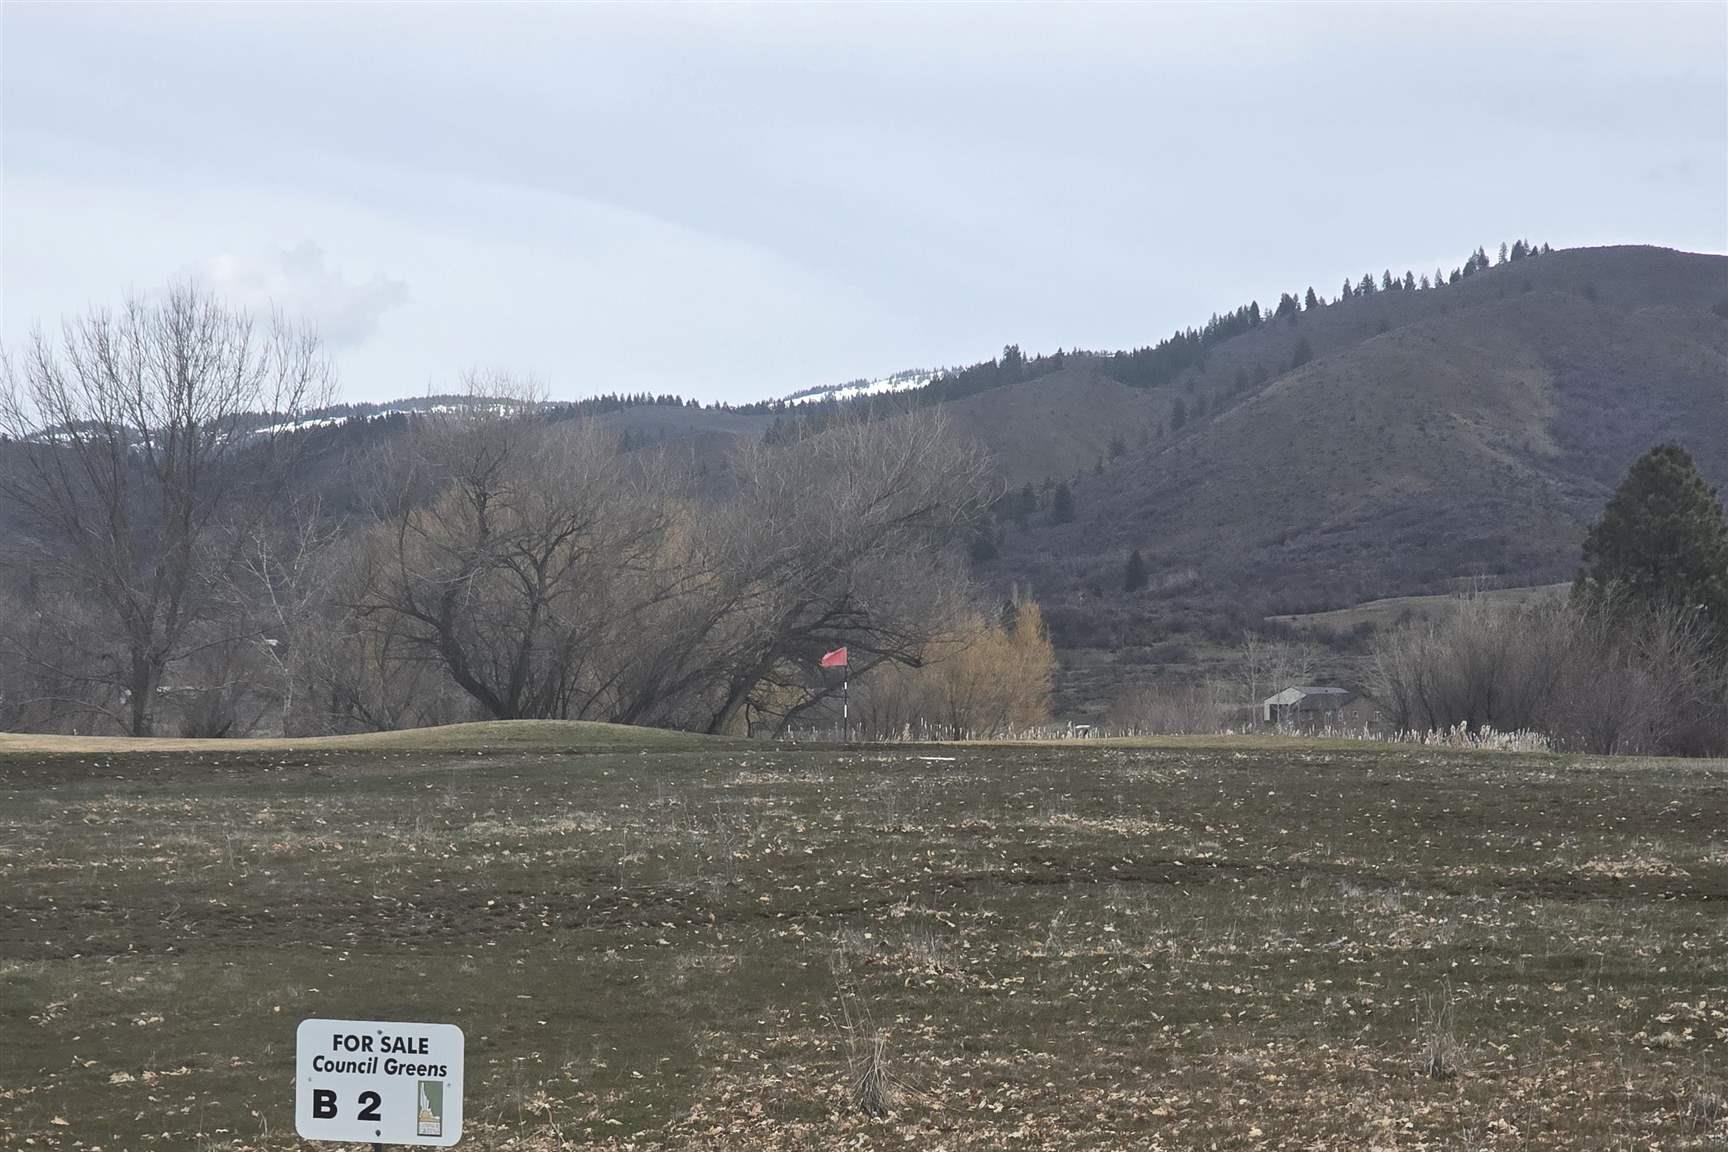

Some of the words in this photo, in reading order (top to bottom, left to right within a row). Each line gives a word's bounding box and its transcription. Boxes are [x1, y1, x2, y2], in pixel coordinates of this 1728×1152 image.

[333, 1034, 374, 1053] FOR
[380, 1035, 429, 1055] SALE
[312, 1055, 379, 1074] Council
[384, 1058, 448, 1078] Greens
[312, 1089, 338, 1119] B
[357, 1091, 382, 1122] 2
